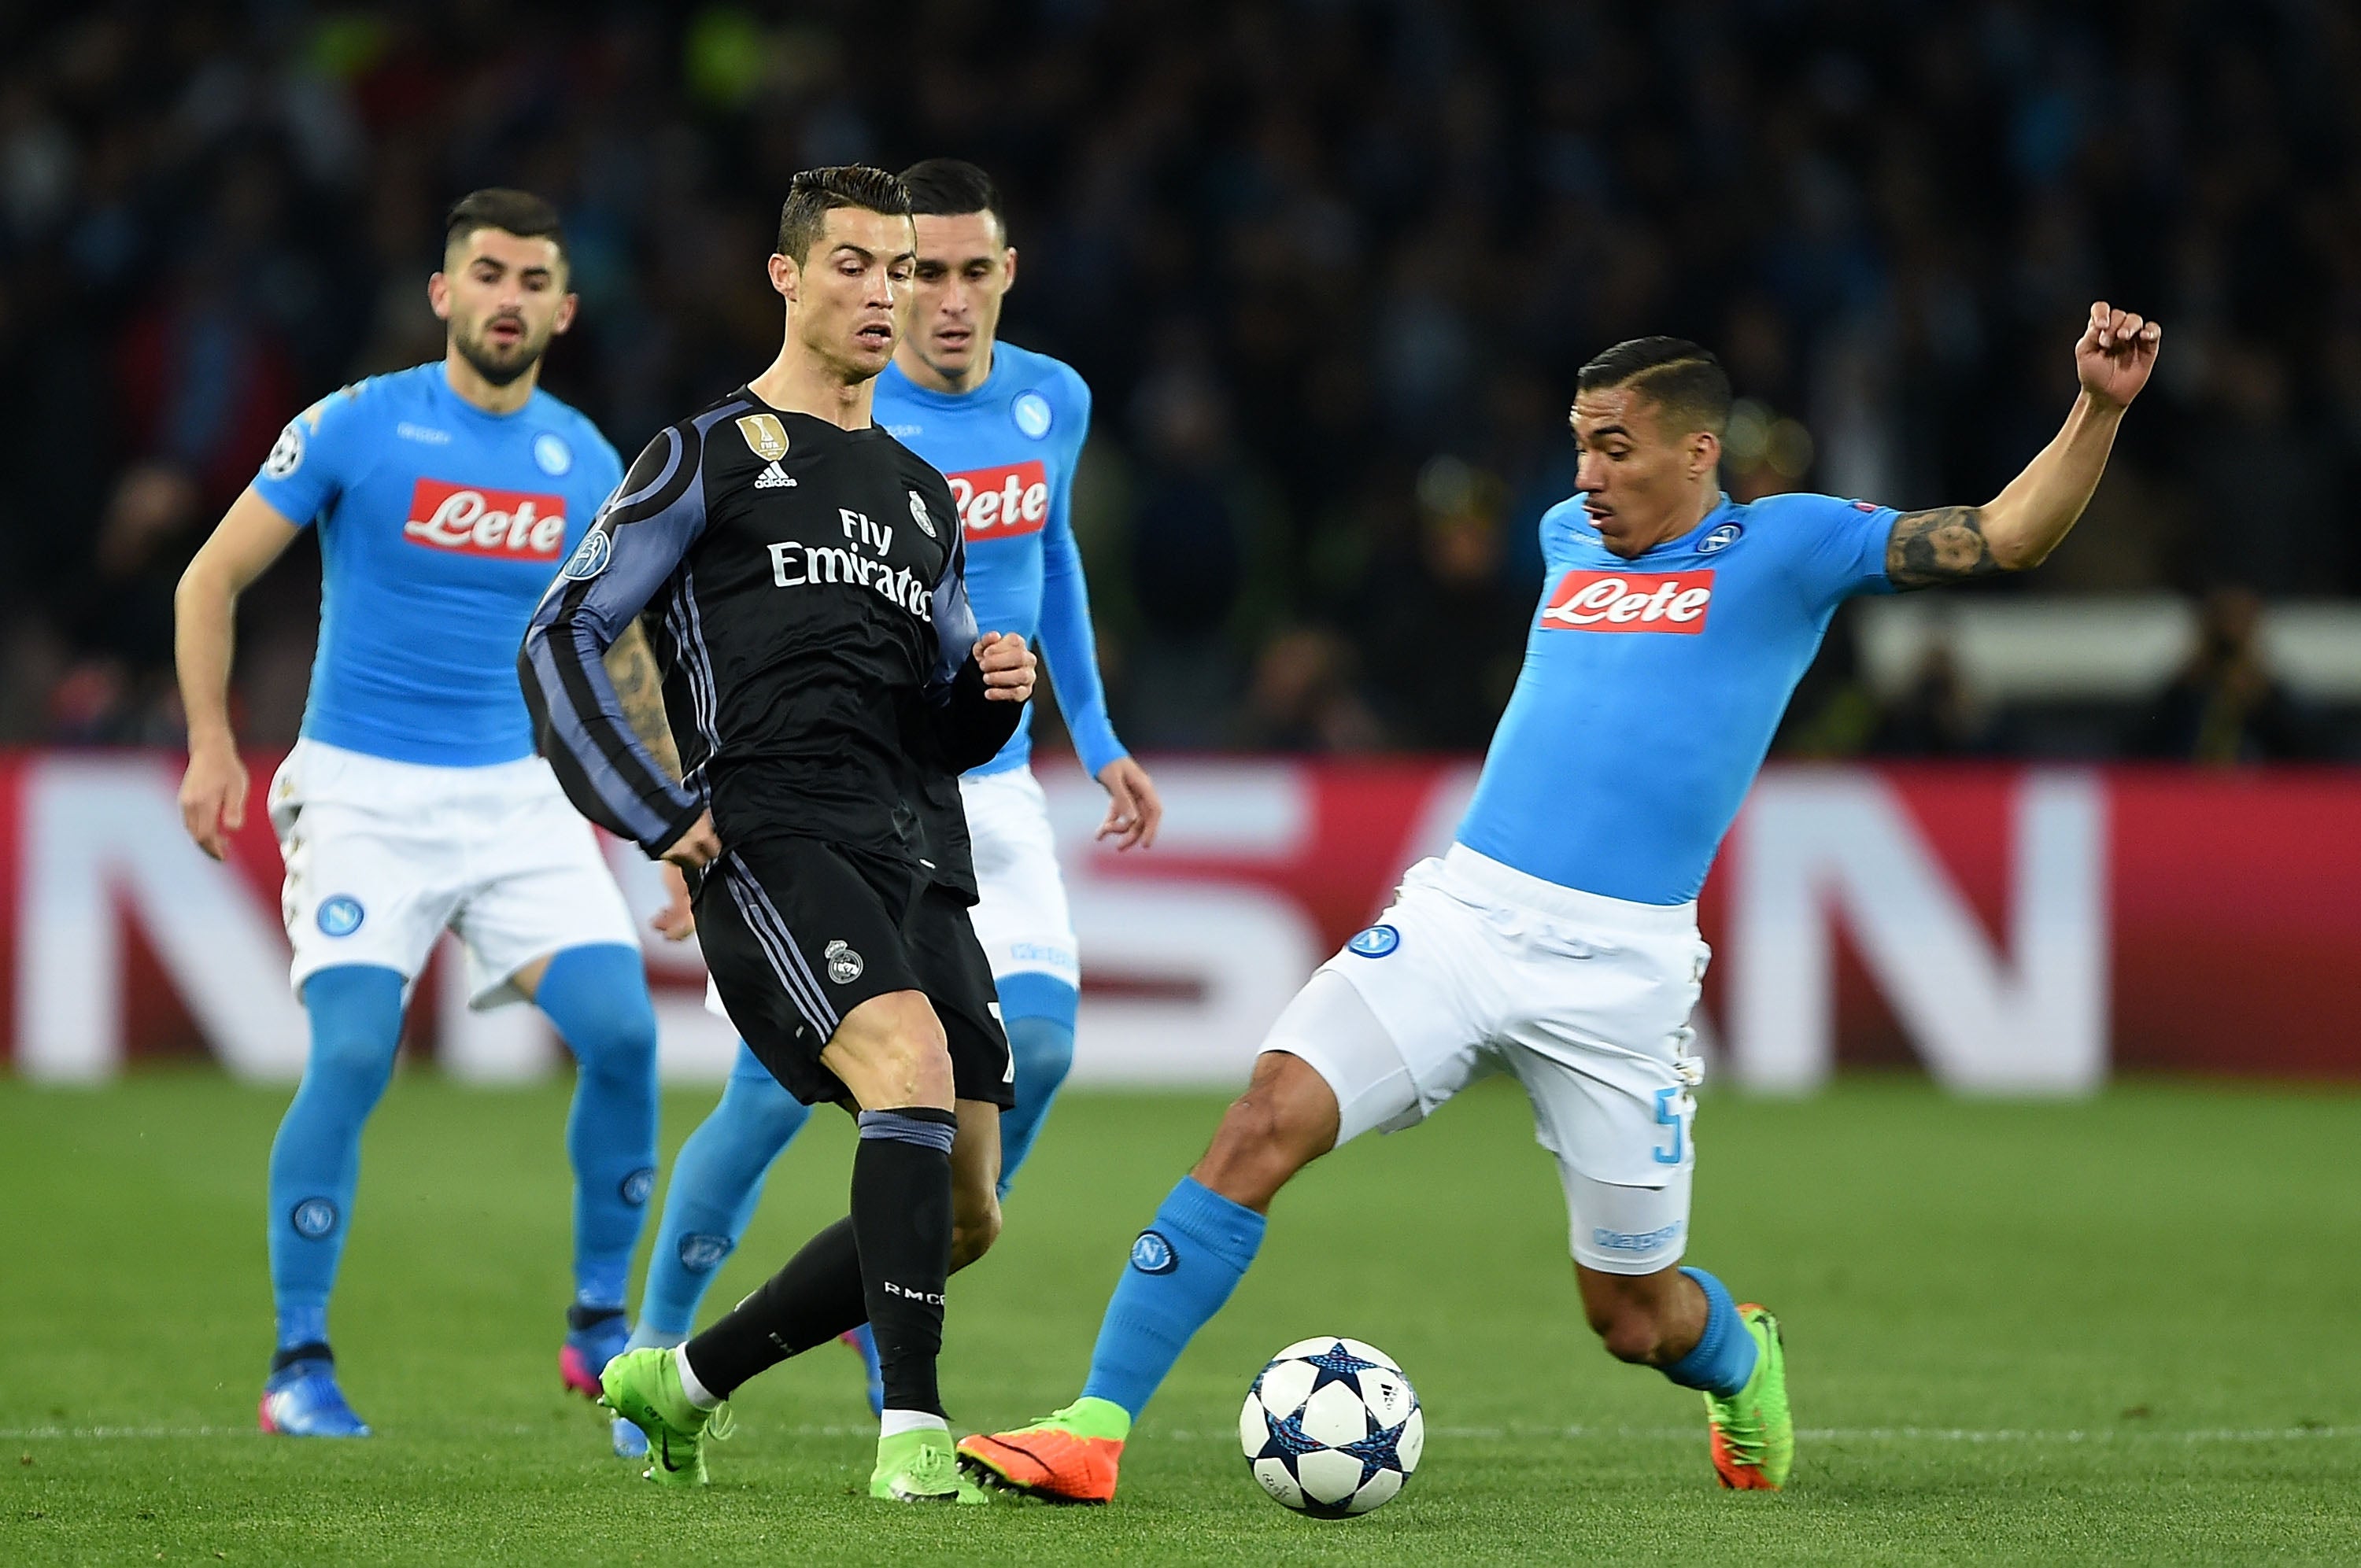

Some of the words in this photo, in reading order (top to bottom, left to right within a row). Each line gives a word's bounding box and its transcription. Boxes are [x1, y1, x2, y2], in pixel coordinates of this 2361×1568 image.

[755, 478, 798, 489] adidas
[404, 489, 566, 552] Lete
[838, 508, 892, 556] Fly
[1543, 577, 1711, 625] Lete
[1656, 1087, 1680, 1163] 5
